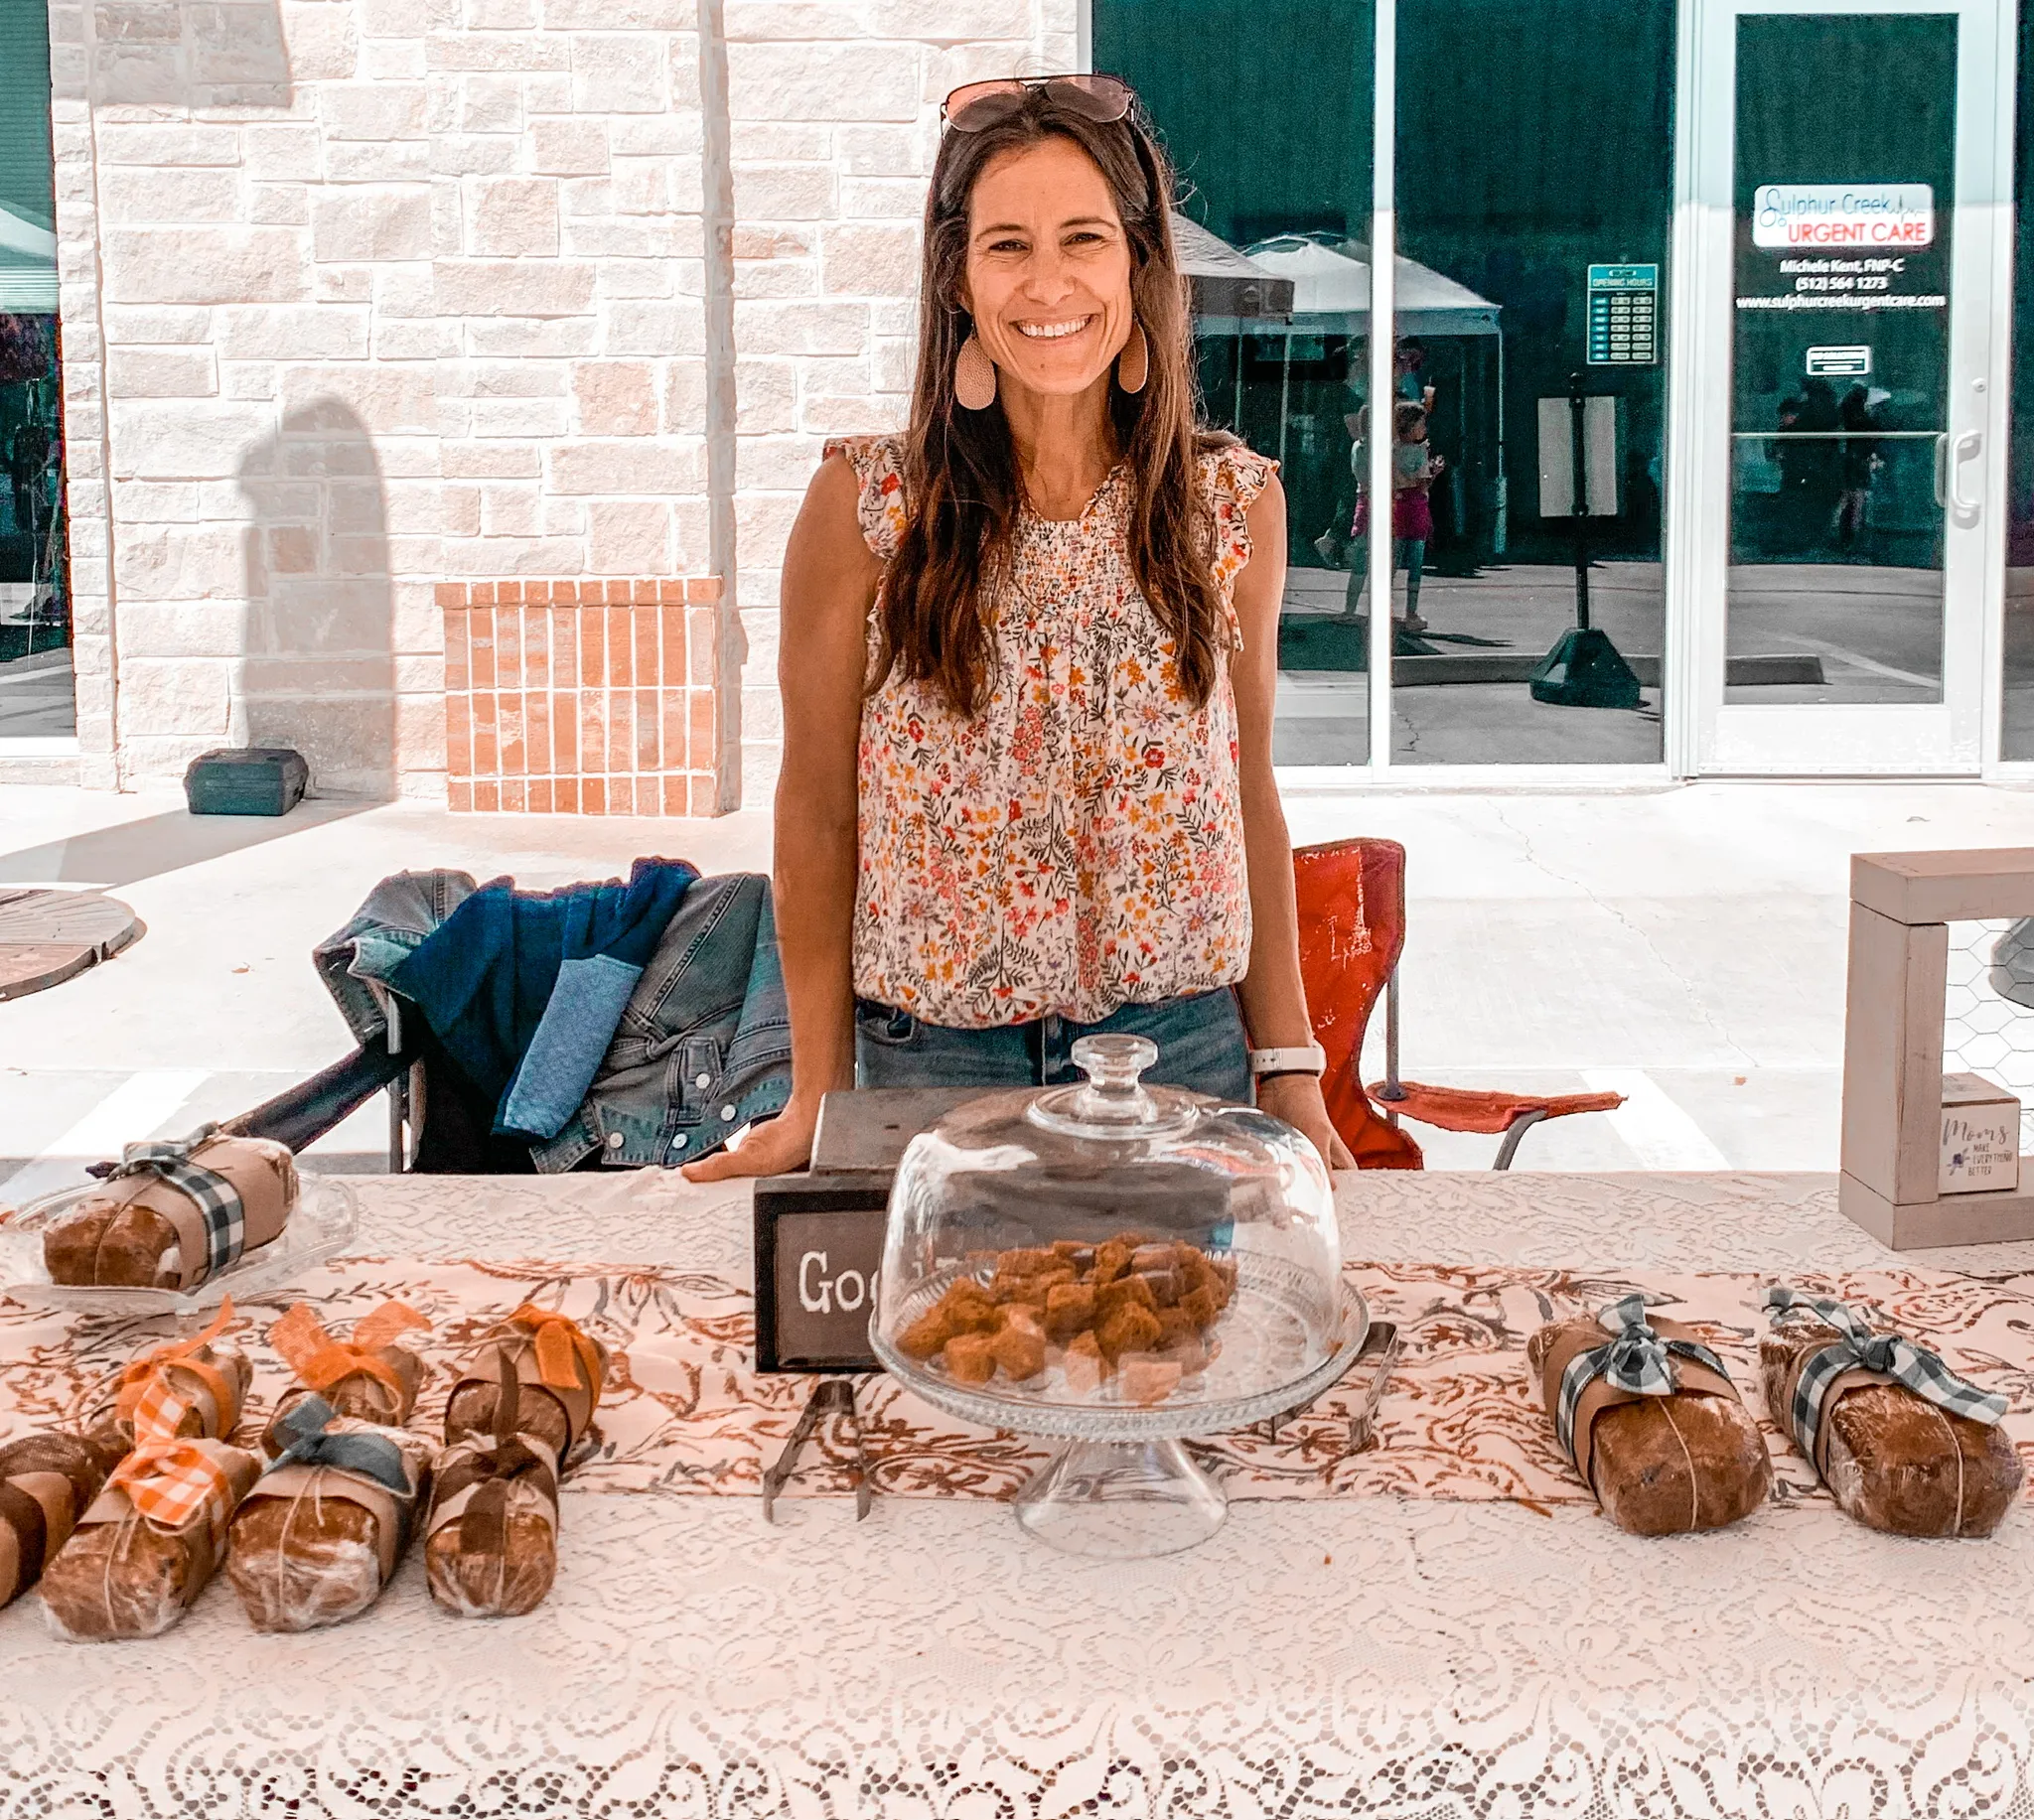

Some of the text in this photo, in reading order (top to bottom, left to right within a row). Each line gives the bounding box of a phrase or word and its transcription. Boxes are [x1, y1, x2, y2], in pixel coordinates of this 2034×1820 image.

[1760, 189, 1890, 227] Sulphur Creek
[1789, 222, 1926, 242] URGENT CARE
[1780, 259, 1829, 273] Michele
[1864, 258, 1905, 272] FNP-C
[1796, 277, 1887, 291] (512) 564 1273
[1736, 294, 1946, 311] www.sulphurcreekurgentcare.com
[1943, 1119, 2008, 1145] Moms
[1967, 1166, 1991, 1177] BETTER
